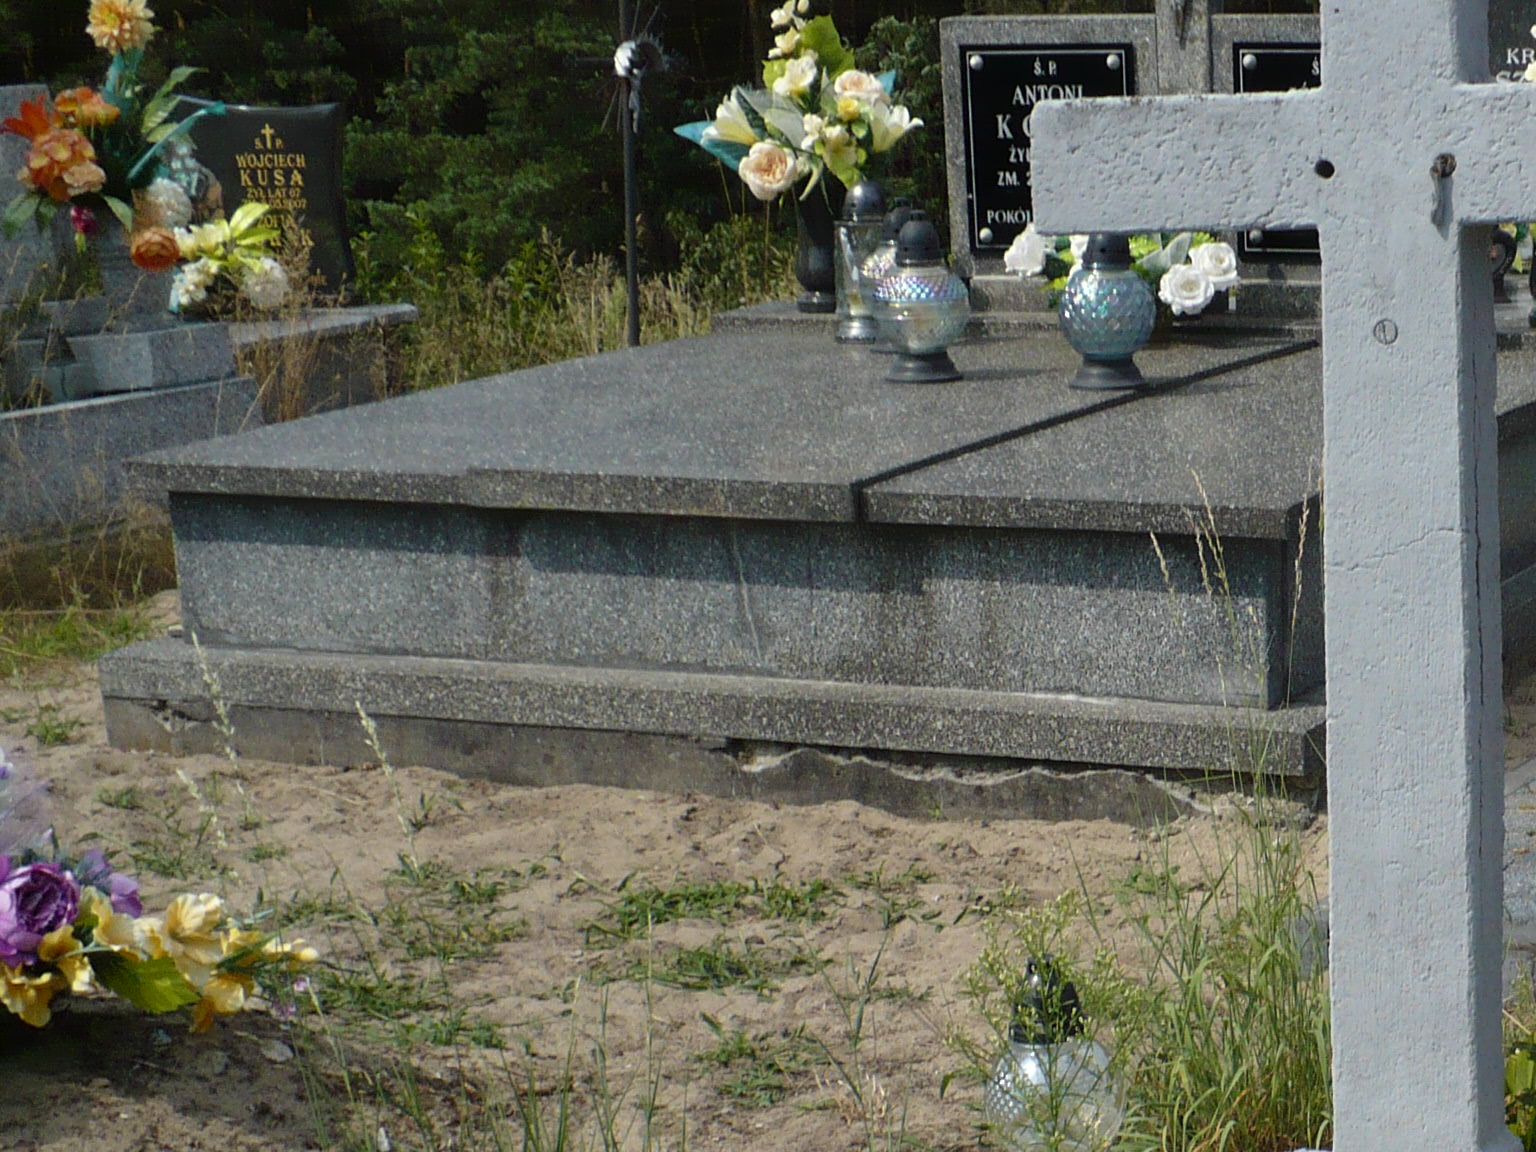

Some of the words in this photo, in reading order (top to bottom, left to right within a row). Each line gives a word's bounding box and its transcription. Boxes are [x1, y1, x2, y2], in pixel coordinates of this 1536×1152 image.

[1012, 85, 1085, 105] ANTONI
[235, 153, 306, 168] WOJCIECH
[240, 170, 304, 187] KUSA
[268, 188, 286, 199] LAT
